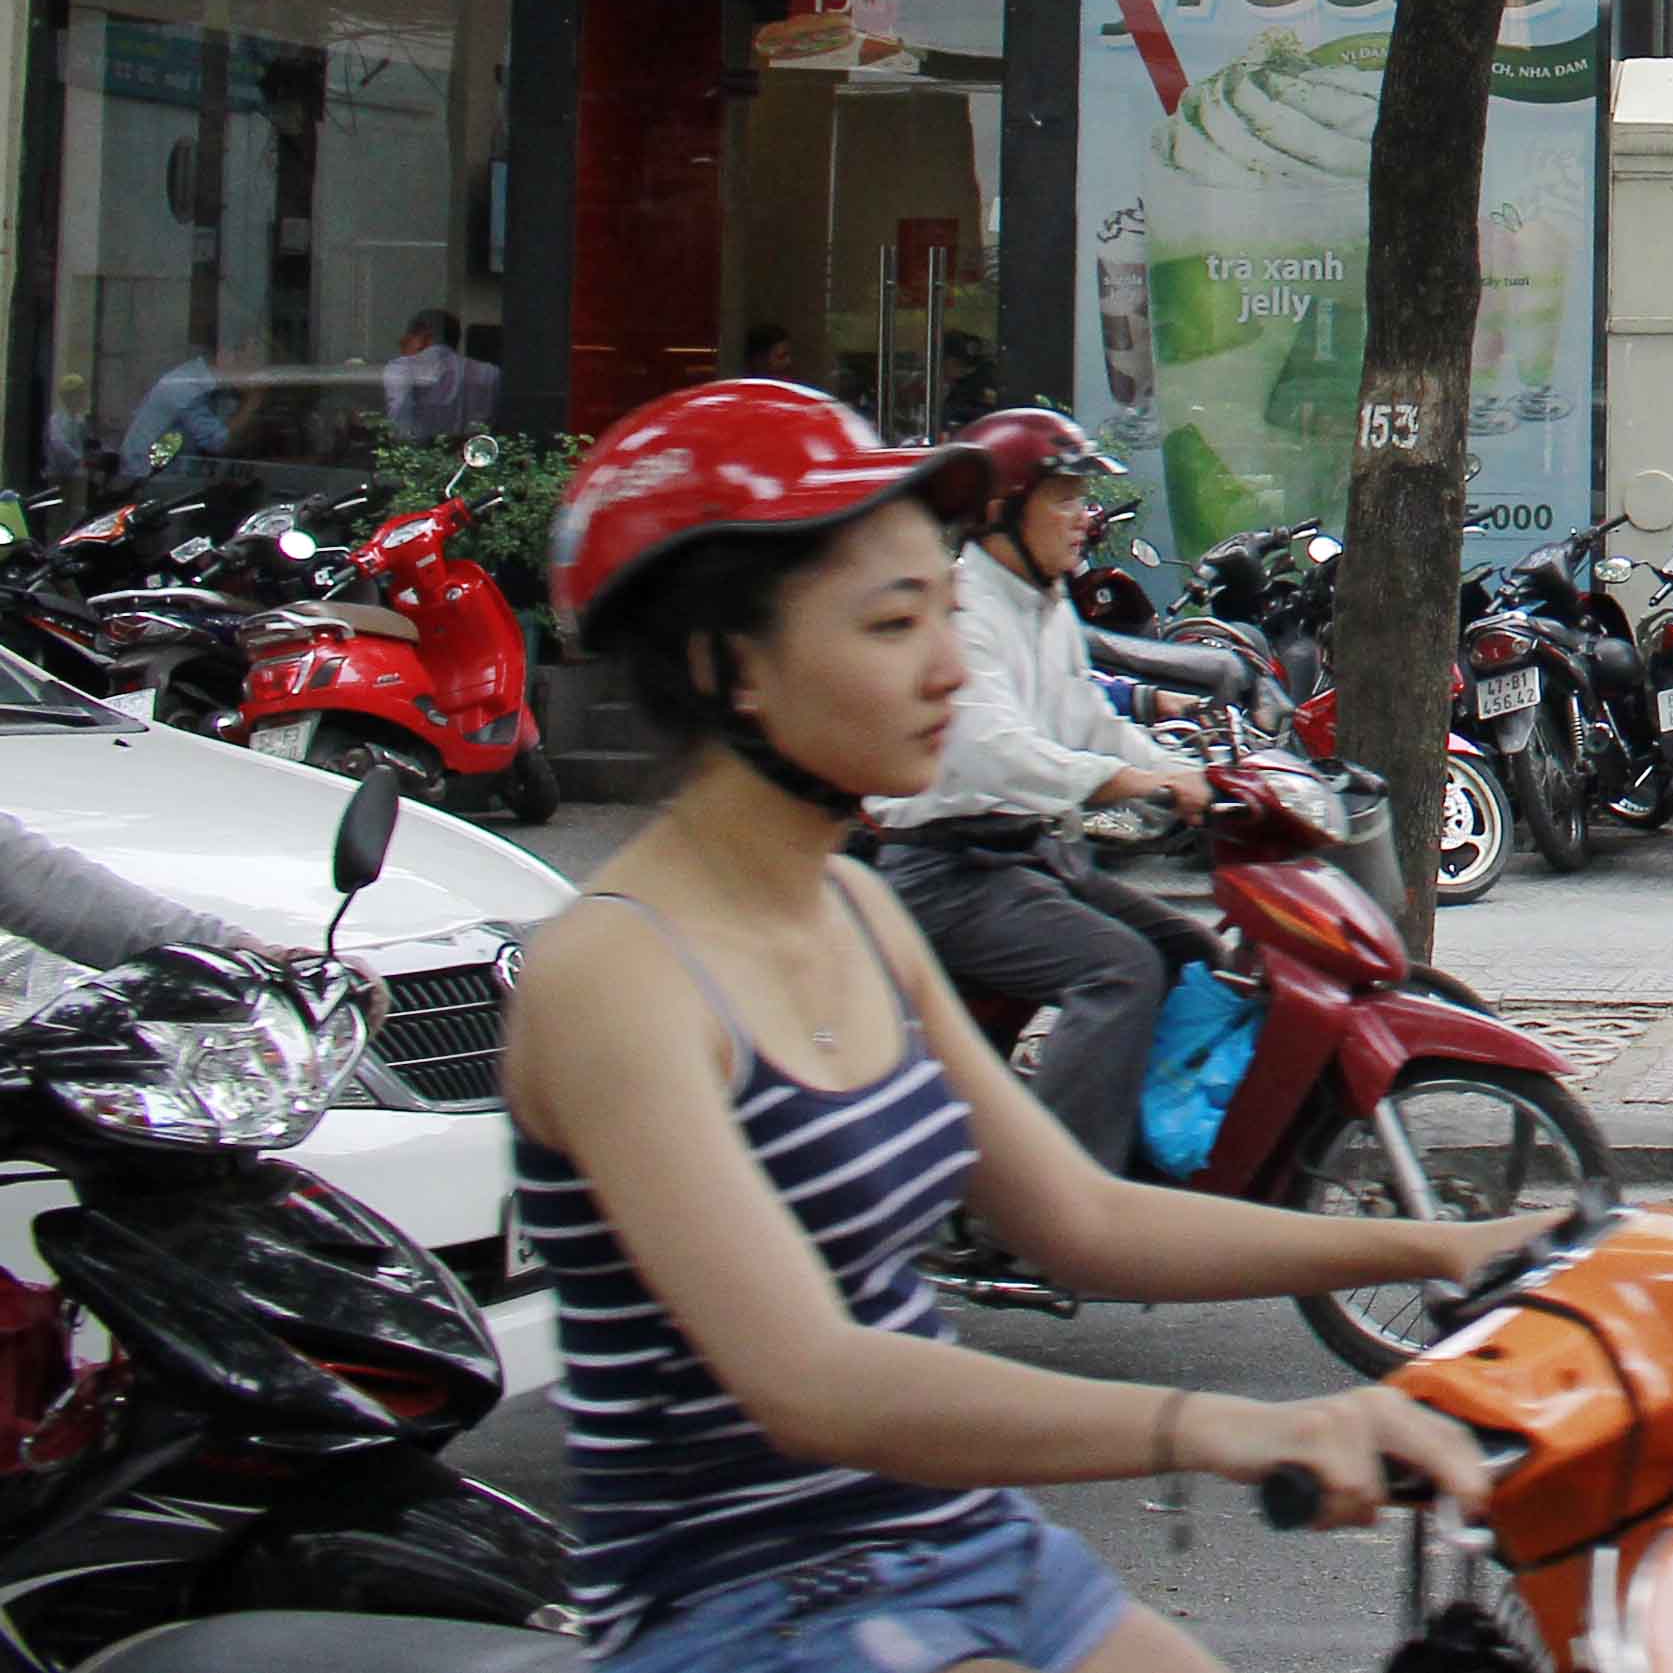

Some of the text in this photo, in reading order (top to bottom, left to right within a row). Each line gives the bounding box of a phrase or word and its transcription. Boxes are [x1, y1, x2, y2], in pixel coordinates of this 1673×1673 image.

[1519, 67, 1551, 79] NHA
[1263, 251, 1344, 281] xanh
[1237, 286, 1312, 323] jelly
